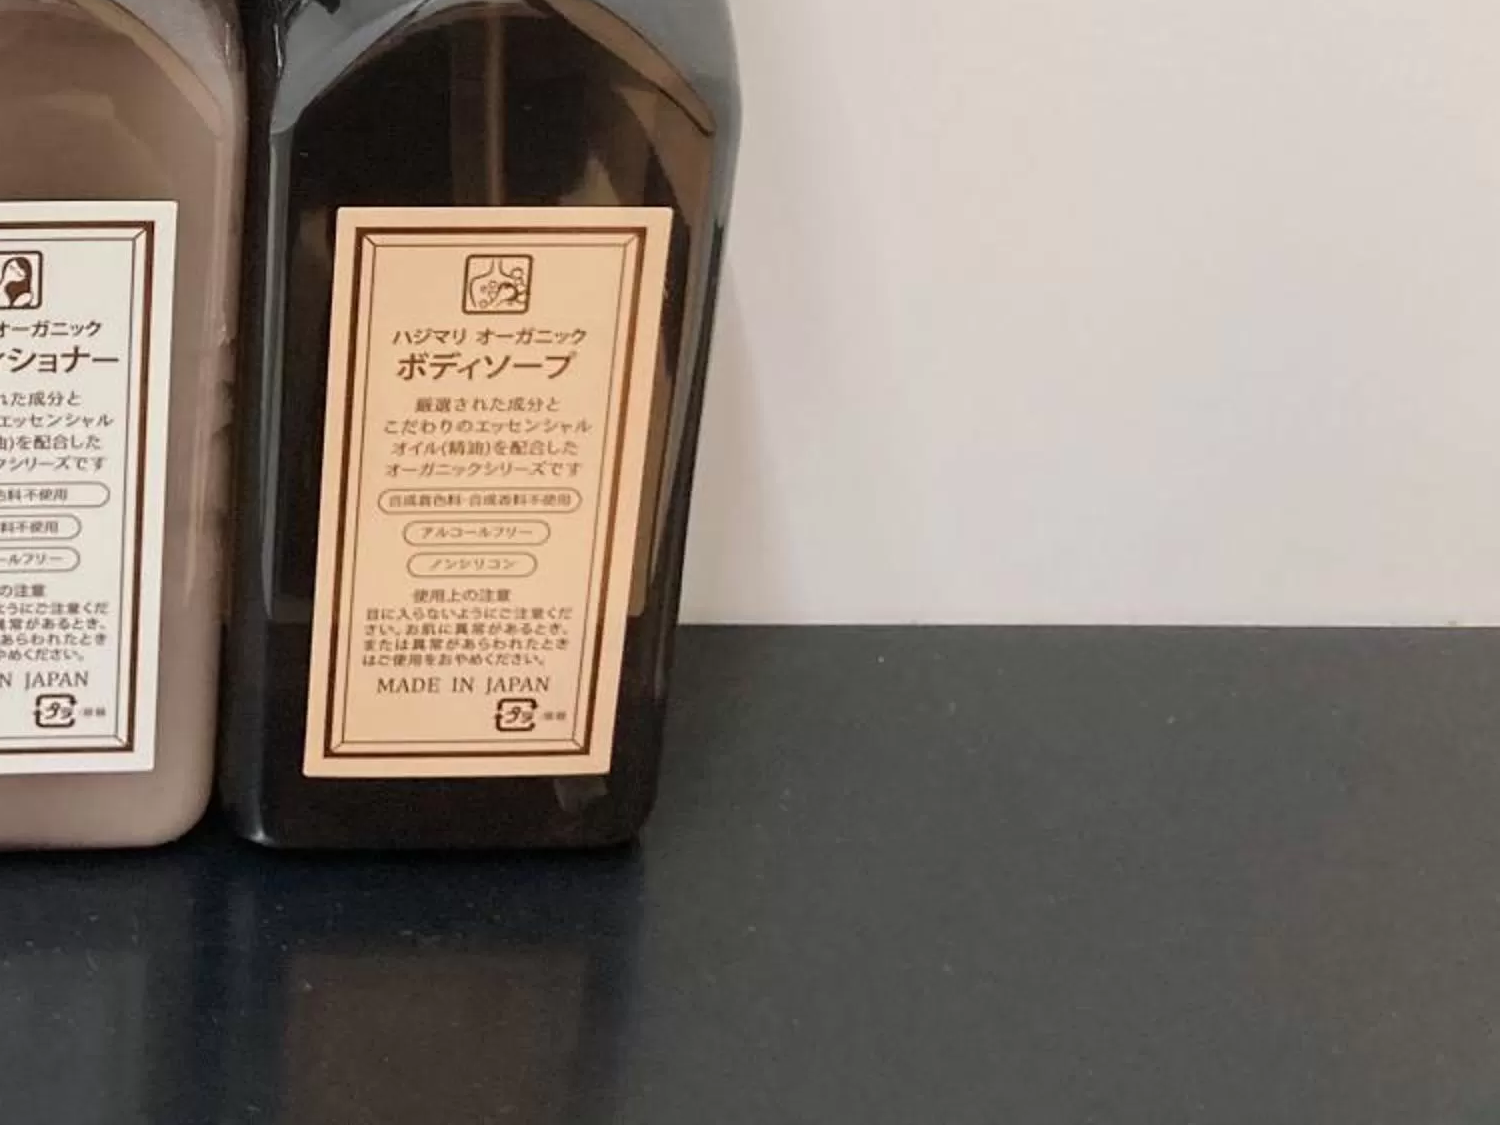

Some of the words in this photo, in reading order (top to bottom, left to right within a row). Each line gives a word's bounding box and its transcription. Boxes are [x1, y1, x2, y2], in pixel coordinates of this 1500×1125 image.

[392, 329, 465, 346] ハジマリ
[475, 328, 587, 344] オーガニック
[397, 351, 577, 380] ボディソープ
[415, 396, 560, 413] 厳選された成分と
[384, 419, 592, 435] こだわりのエッセンシャル
[385, 461, 582, 478] オーガニックシリーズです
[429, 558, 515, 571] ノンシリコン
[413, 588, 511, 604] 使用上の注意
[24, 671, 89, 691] JAPAN
[377, 677, 441, 694] MADE
[451, 677, 474, 692] IN
[484, 676, 550, 695] JAPAN
